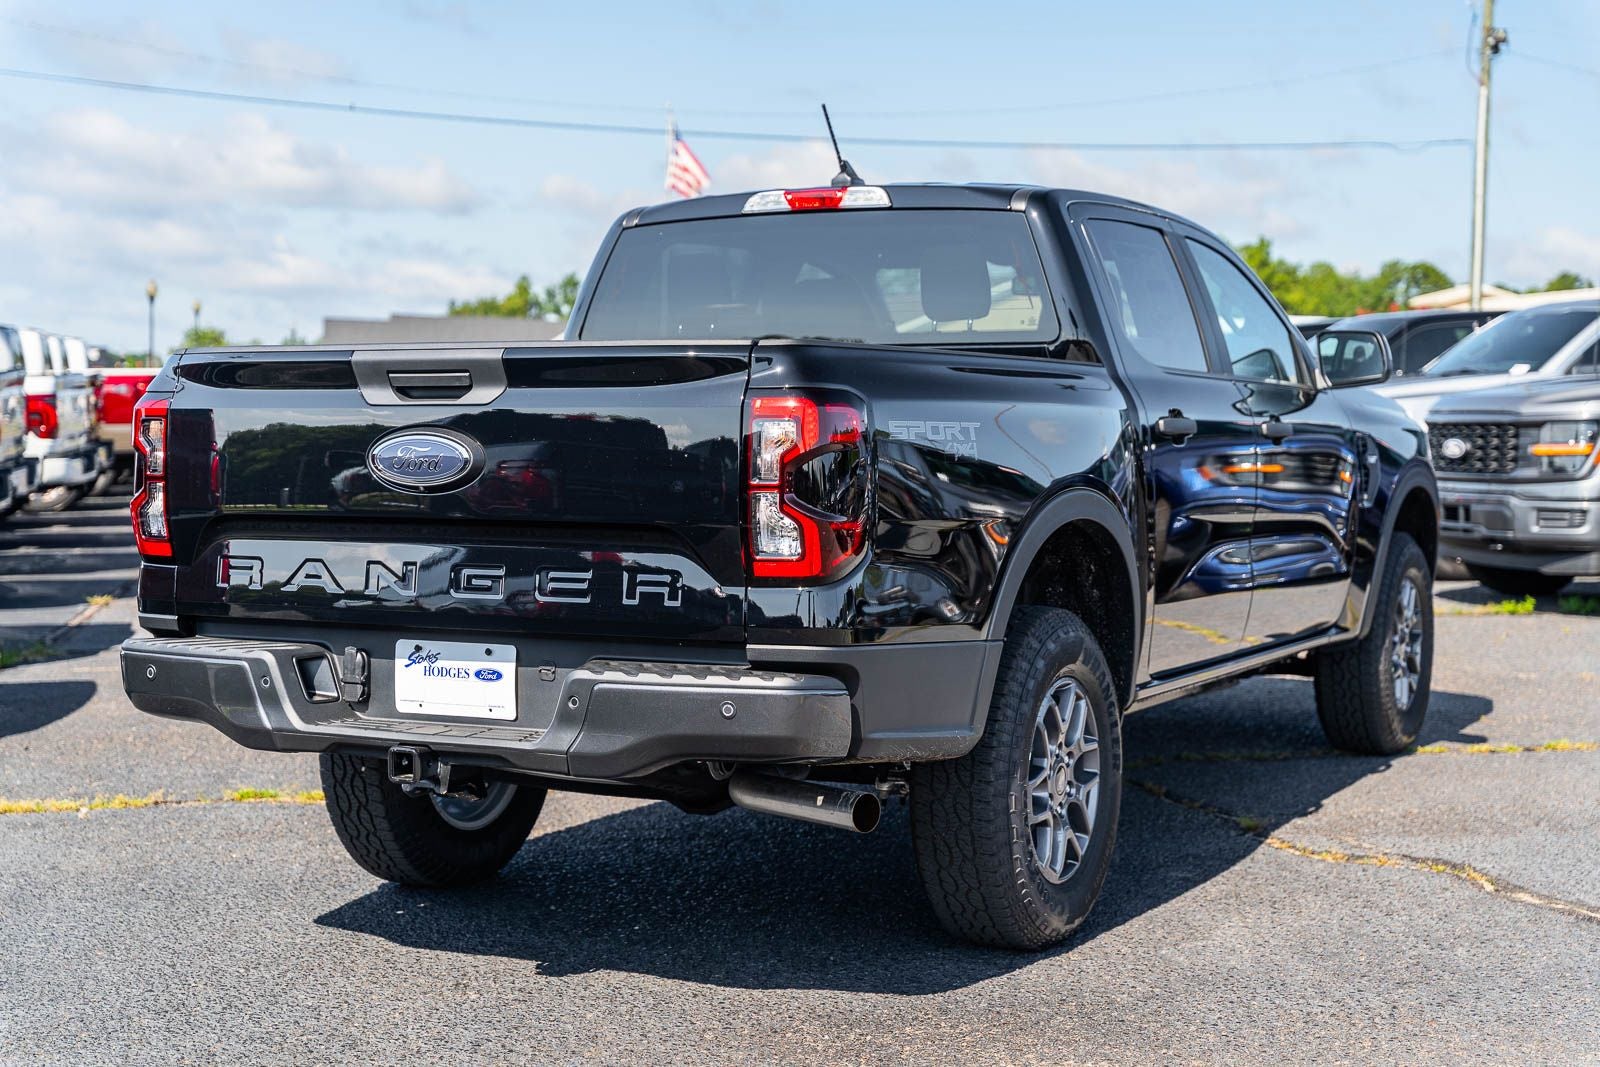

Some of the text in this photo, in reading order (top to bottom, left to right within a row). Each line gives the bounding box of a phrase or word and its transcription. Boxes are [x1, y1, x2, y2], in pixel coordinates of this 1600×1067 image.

[888, 420, 981, 441] SPORT
[391, 445, 443, 472] Ford
[215, 554, 684, 608] RANGER
[404, 649, 441, 668] Stokes
[423, 665, 498, 680] HODGES Ford
